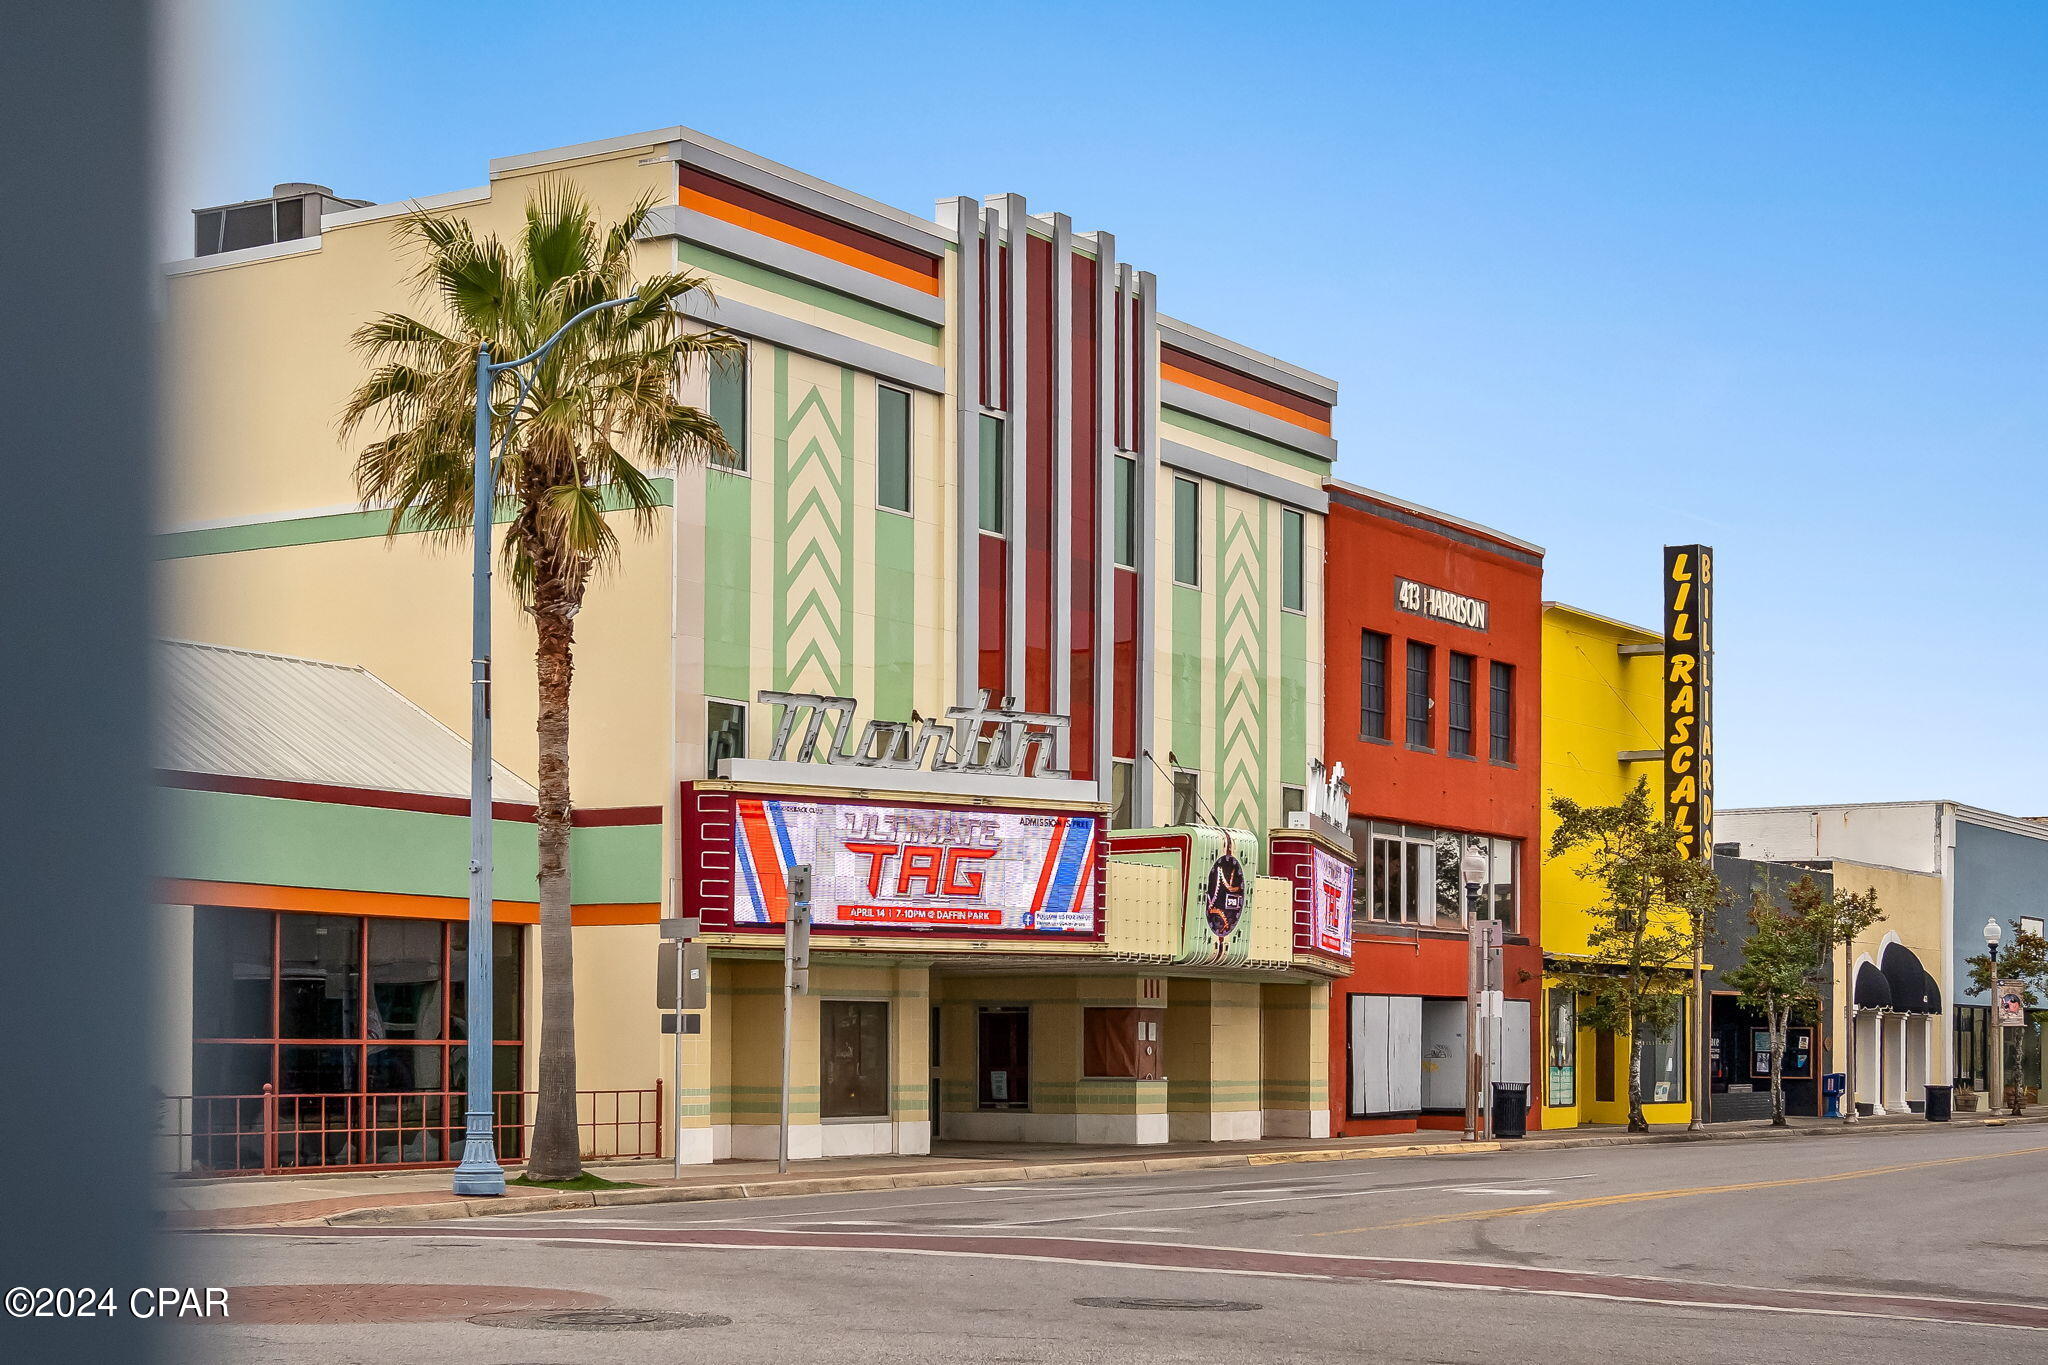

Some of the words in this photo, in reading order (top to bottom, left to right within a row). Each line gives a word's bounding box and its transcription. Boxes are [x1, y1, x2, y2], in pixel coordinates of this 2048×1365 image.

[1399, 581, 1420, 611] 413
[1423, 587, 1485, 629] HARRISON
[1671, 553, 1693, 641] LIL
[757, 688, 1072, 780] Martin
[1701, 553, 1712, 861] BILLIARDS
[1669, 653, 1695, 861] RASCALS
[845, 812, 1003, 847] ULTIMATE
[1020, 816, 1063, 828] ADMISSION
[843, 841, 1001, 901] TAG
[850, 907, 875, 918] APRIL
[876, 908, 886, 918] 14
[895, 909, 927, 919] 7-10PM
[936, 911, 966, 921] DAFFIN
[967, 911, 990, 921] PARK
